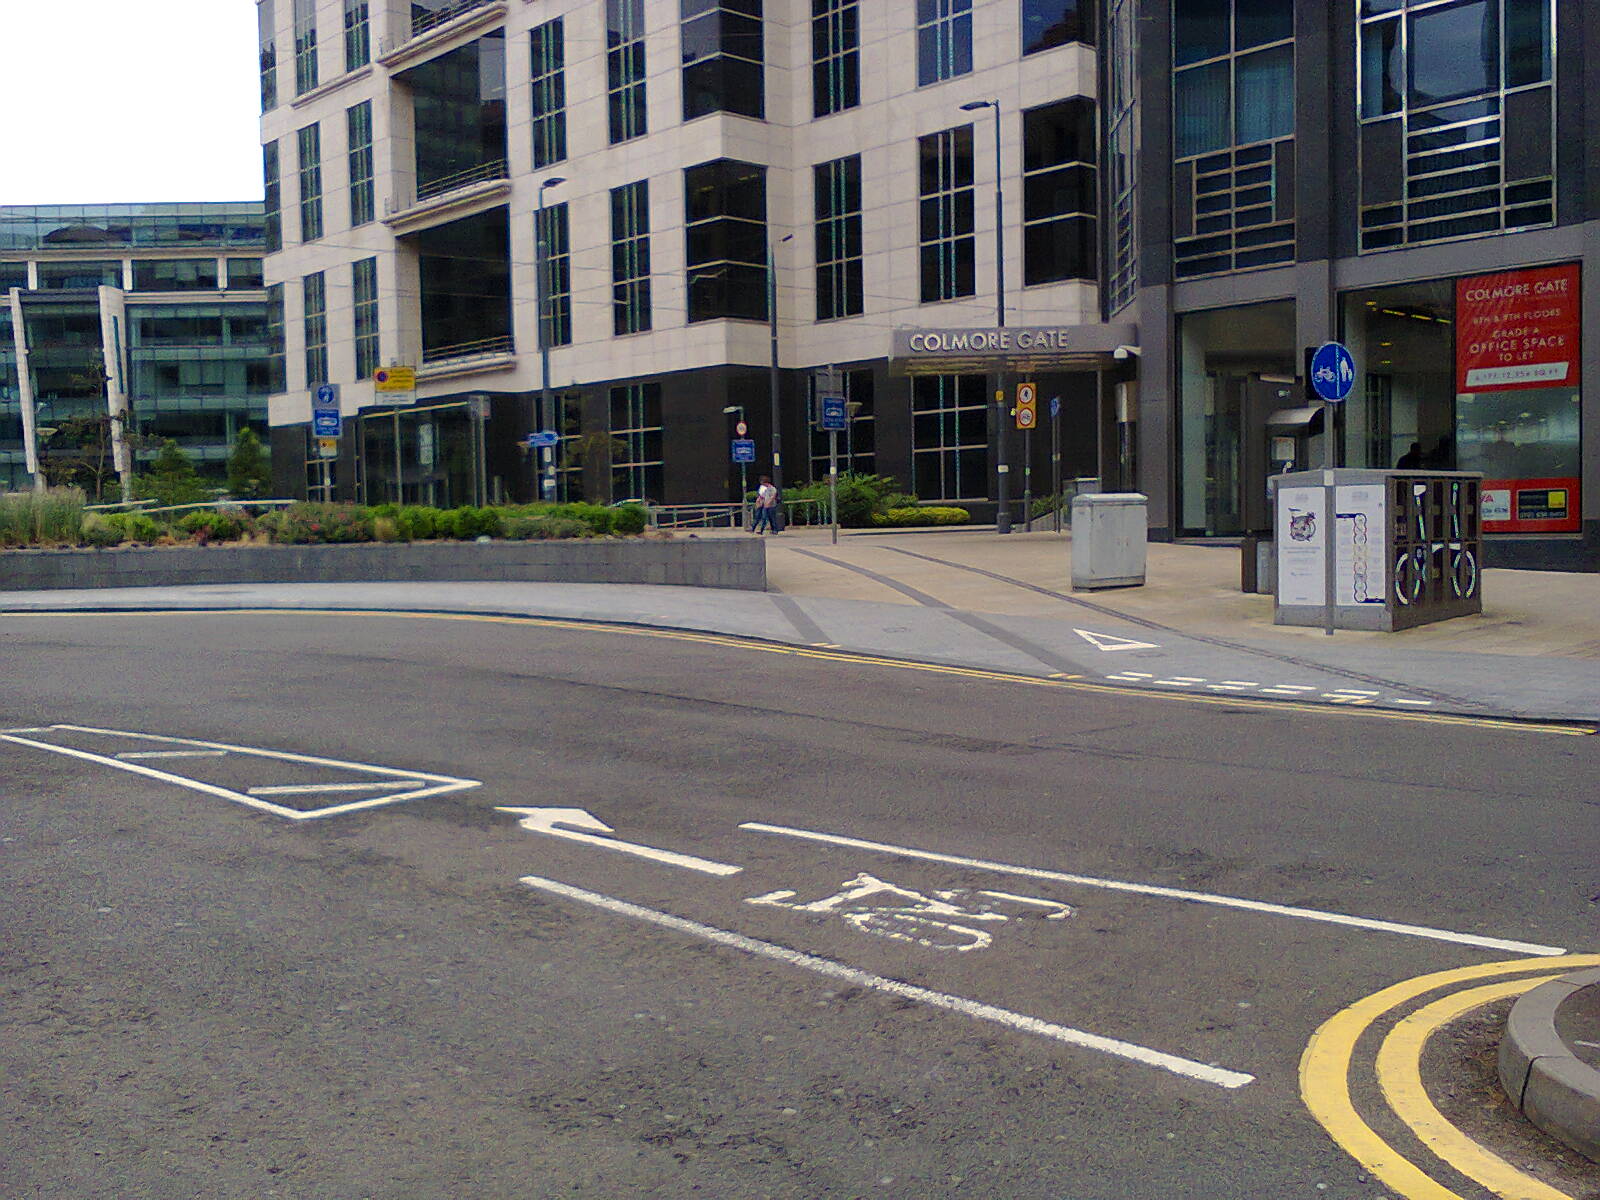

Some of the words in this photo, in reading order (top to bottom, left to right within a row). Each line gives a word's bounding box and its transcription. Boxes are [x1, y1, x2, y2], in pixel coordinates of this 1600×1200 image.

[1466, 284, 1530, 301] COLMORE
[1534, 278, 1568, 295] GATE
[1524, 309, 1560, 319] FLOORS
[909, 332, 1009, 351] COLMORE
[1016, 329, 1070, 349] GATE
[1492, 327, 1528, 338] GRADE
[1470, 341, 1518, 354] OFFICE
[1523, 336, 1565, 350] SPACE
[1499, 352, 1513, 362] TO
[1516, 350, 1534, 361] LET
